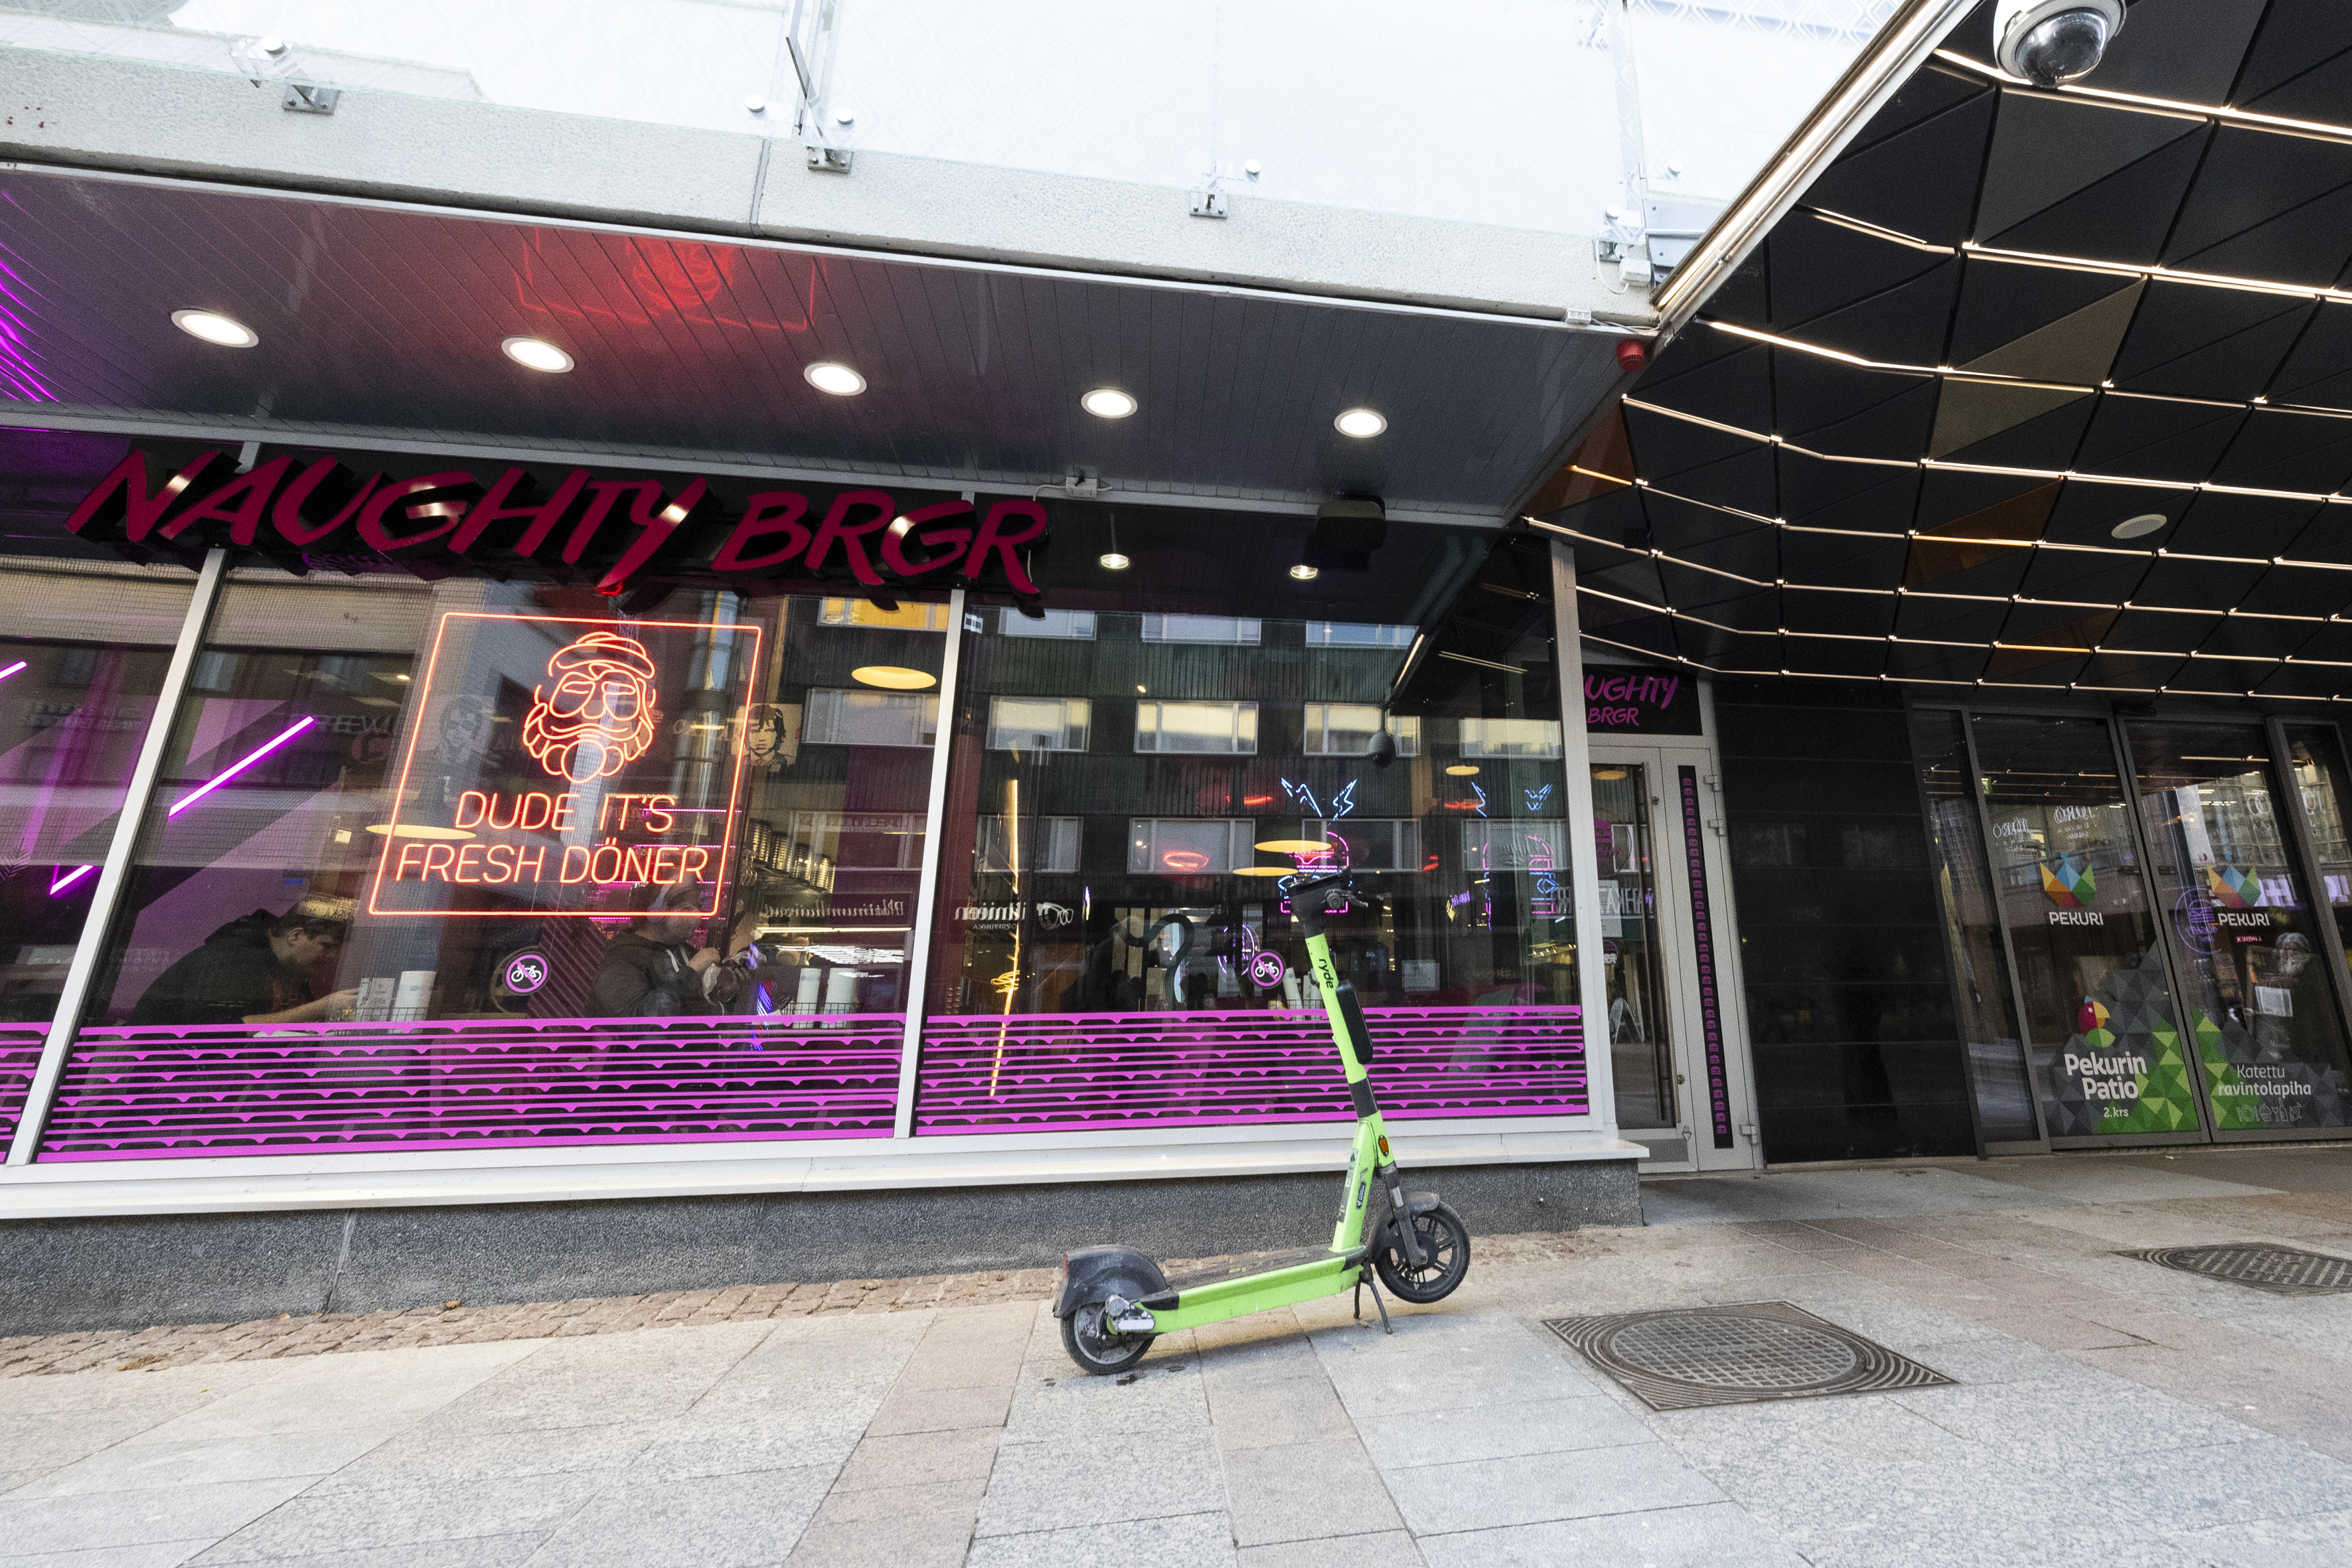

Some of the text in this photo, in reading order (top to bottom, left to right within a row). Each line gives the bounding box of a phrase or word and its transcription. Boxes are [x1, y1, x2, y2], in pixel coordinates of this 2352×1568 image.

[64, 449, 1048, 597] NAUGHTY BRGR
[1583, 674, 1680, 710] UGHTY
[1587, 706, 1640, 726] BRGR
[455, 791, 676, 832] DUDE IT'S
[396, 836, 710, 885] FRESH DÖNER
[2049, 911, 2104, 926] PEKURI
[2217, 912, 2270, 927] PEKURI
[1319, 959, 1334, 988] ryde
[2064, 1052, 2148, 1077] Pekurin
[2236, 1063, 2286, 1079] Katettu
[2082, 1075, 2139, 1100] Patio
[2217, 1080, 2312, 1099] ravintolapiha
